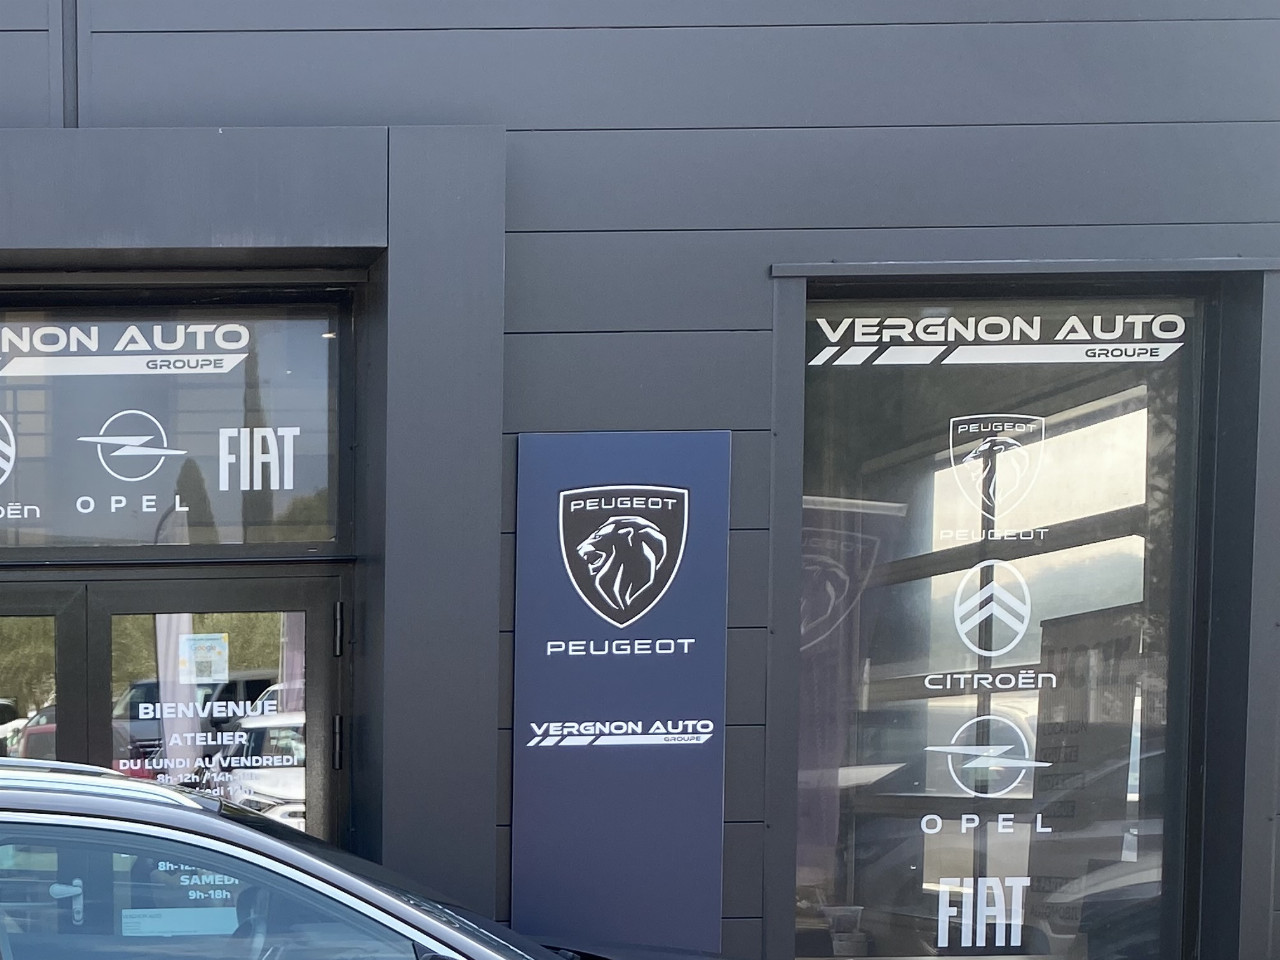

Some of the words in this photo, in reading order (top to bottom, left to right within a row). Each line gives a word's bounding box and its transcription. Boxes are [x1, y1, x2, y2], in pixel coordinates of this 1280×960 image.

[816, 316, 1041, 343] VERGNON
[1053, 313, 1186, 340] AUTO
[112, 323, 250, 352] AUTO
[1085, 347, 1160, 358] GROUPE
[145, 357, 225, 370] GROUPE
[957, 422, 1037, 434] PEUGEOT
[218, 426, 301, 491] FIAT
[75, 494, 190, 514] OPEL
[570, 497, 677, 512] PEUGEOT
[940, 528, 1049, 541] PEUGEOT
[546, 638, 696, 656] PEUGEOT
[924, 670, 1057, 689] CITROËN
[138, 700, 278, 719] BIENVENUE
[530, 720, 643, 735] VERGNON
[648, 719, 714, 733] AUTO
[169, 731, 248, 746] ATELIER
[120, 759, 142, 770] DU
[144, 758, 190, 770] LUNDI
[194, 757, 218, 768] AU
[219, 755, 298, 768] VENDREDI
[156, 772, 200, 783] 8h-12h
[921, 813, 1053, 834] OPEL
[188, 889, 231, 900] 9h-18h
[937, 876, 1031, 948] FIAT
